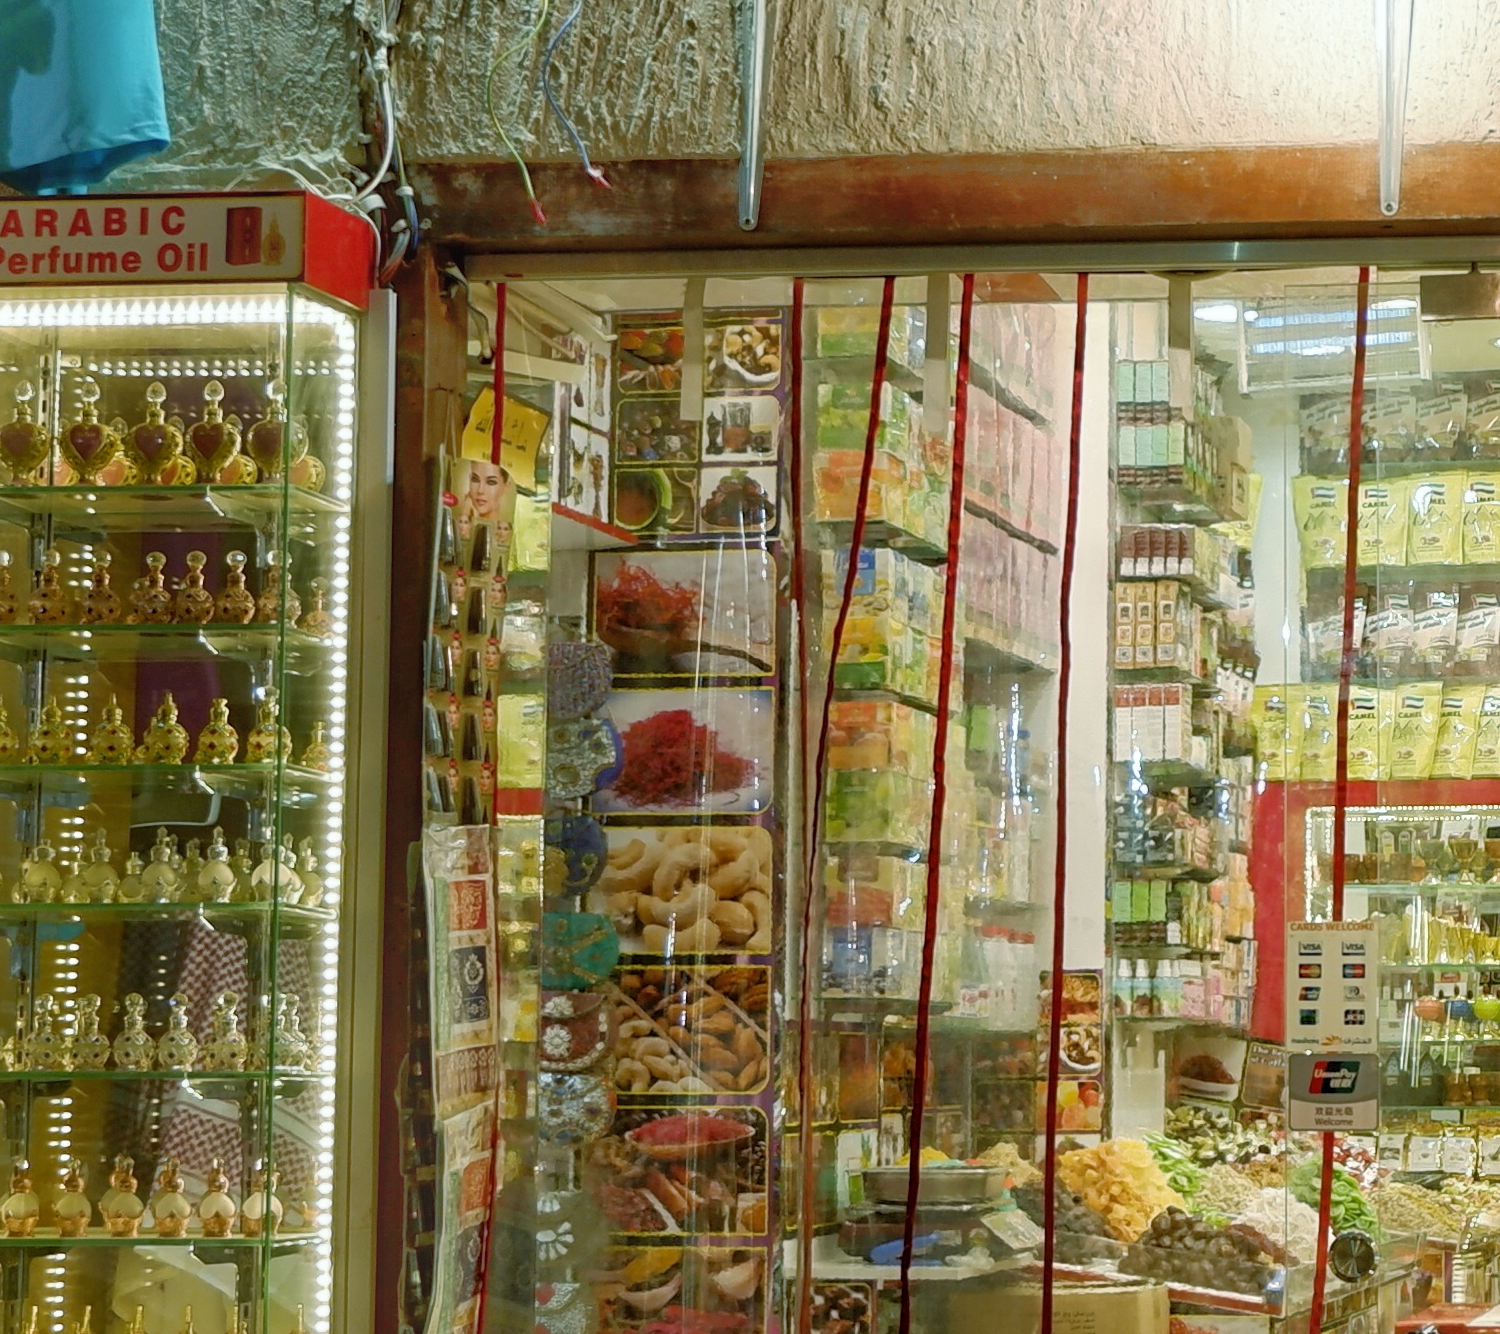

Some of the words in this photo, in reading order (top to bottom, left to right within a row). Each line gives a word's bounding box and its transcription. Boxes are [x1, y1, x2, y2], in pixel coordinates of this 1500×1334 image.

[0, 205, 187, 239] ARABIC
[157, 242, 209, 273] Oil
[1349, 712, 1376, 720] CAMEL
[1290, 922, 1323, 932] CARDS
[1326, 922, 1375, 932] WELCOME
[1301, 943, 1322, 951] VISA
[1345, 943, 1366, 951] VISA
[1314, 1068, 1357, 1080] UnionPay
[1315, 1117, 1354, 1126] Welcome
